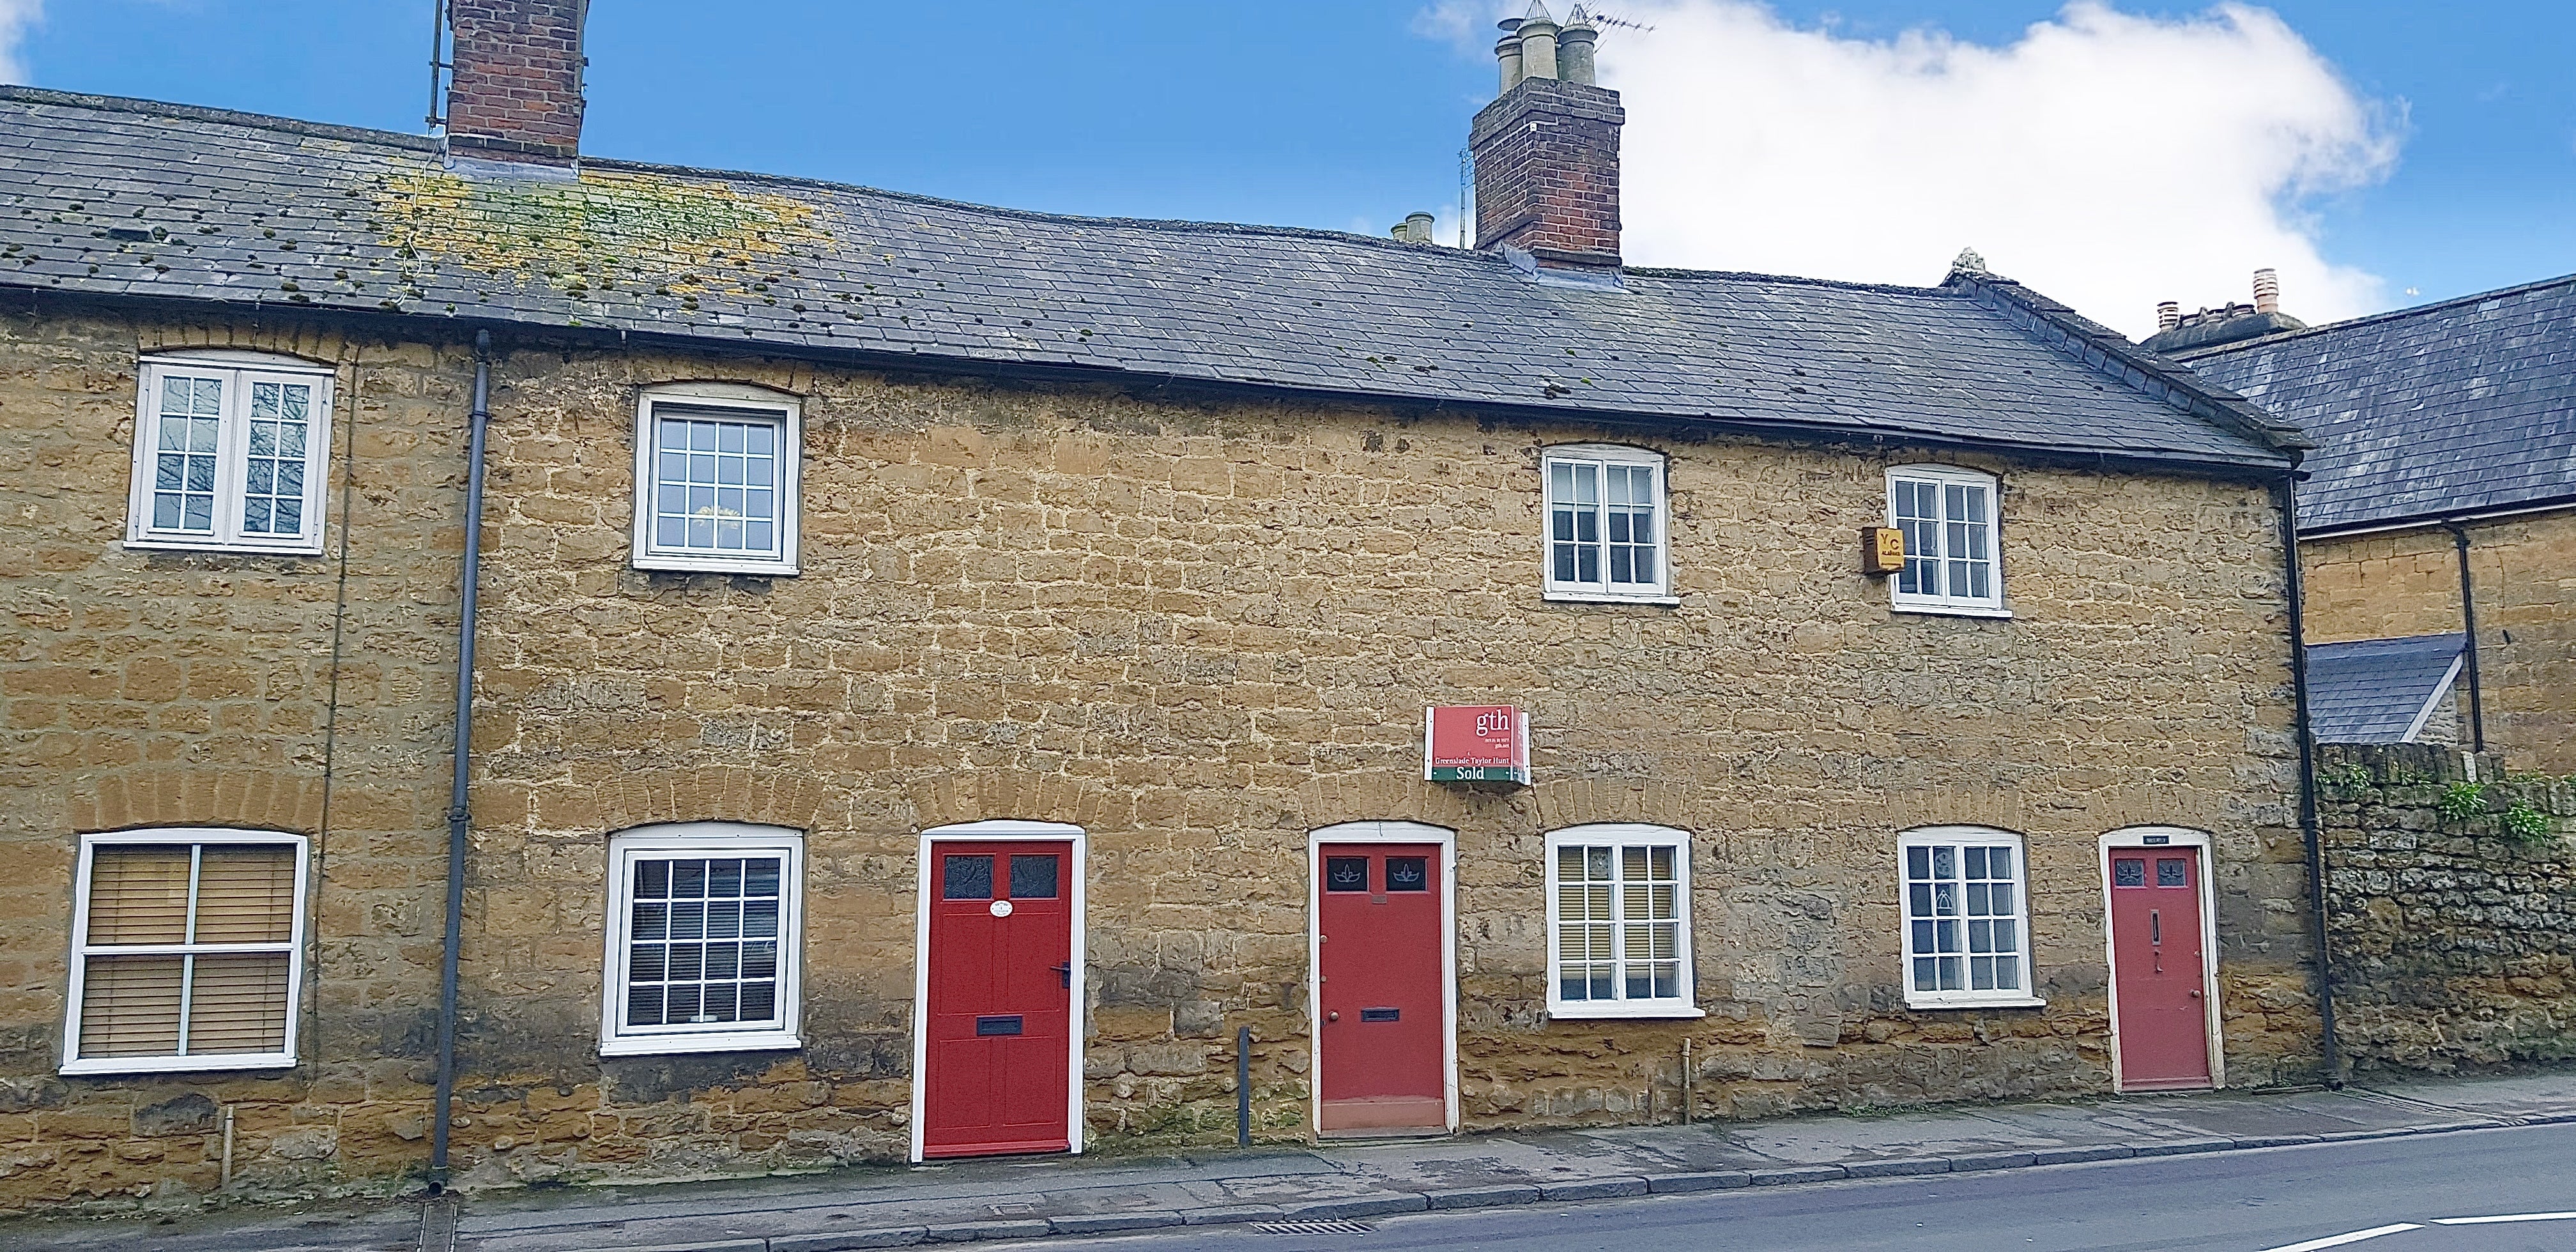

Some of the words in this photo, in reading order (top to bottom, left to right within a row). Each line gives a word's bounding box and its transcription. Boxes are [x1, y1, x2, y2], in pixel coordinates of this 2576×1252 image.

[1475, 708, 1510, 737] gth
[1471, 756, 1492, 766] Taylor
[1456, 766, 1485, 780] Sold
